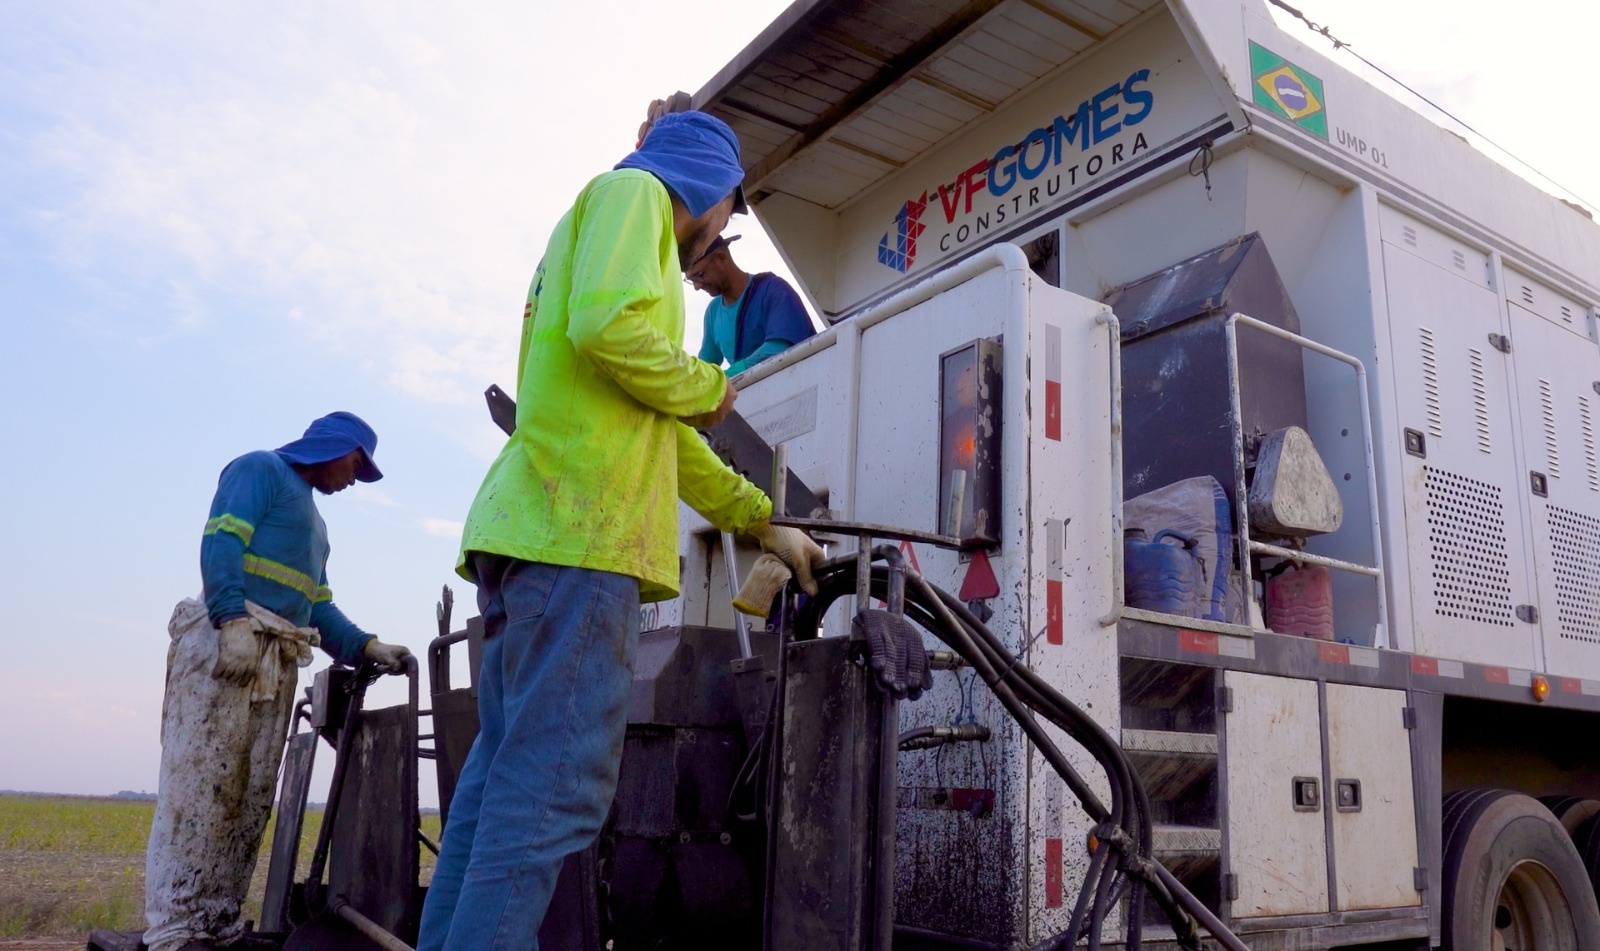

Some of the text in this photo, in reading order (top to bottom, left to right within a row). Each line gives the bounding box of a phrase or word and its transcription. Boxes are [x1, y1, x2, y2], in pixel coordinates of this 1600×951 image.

[1336, 126, 1389, 169] UMP 01
[939, 132, 1148, 252] CONSTRUTORA
